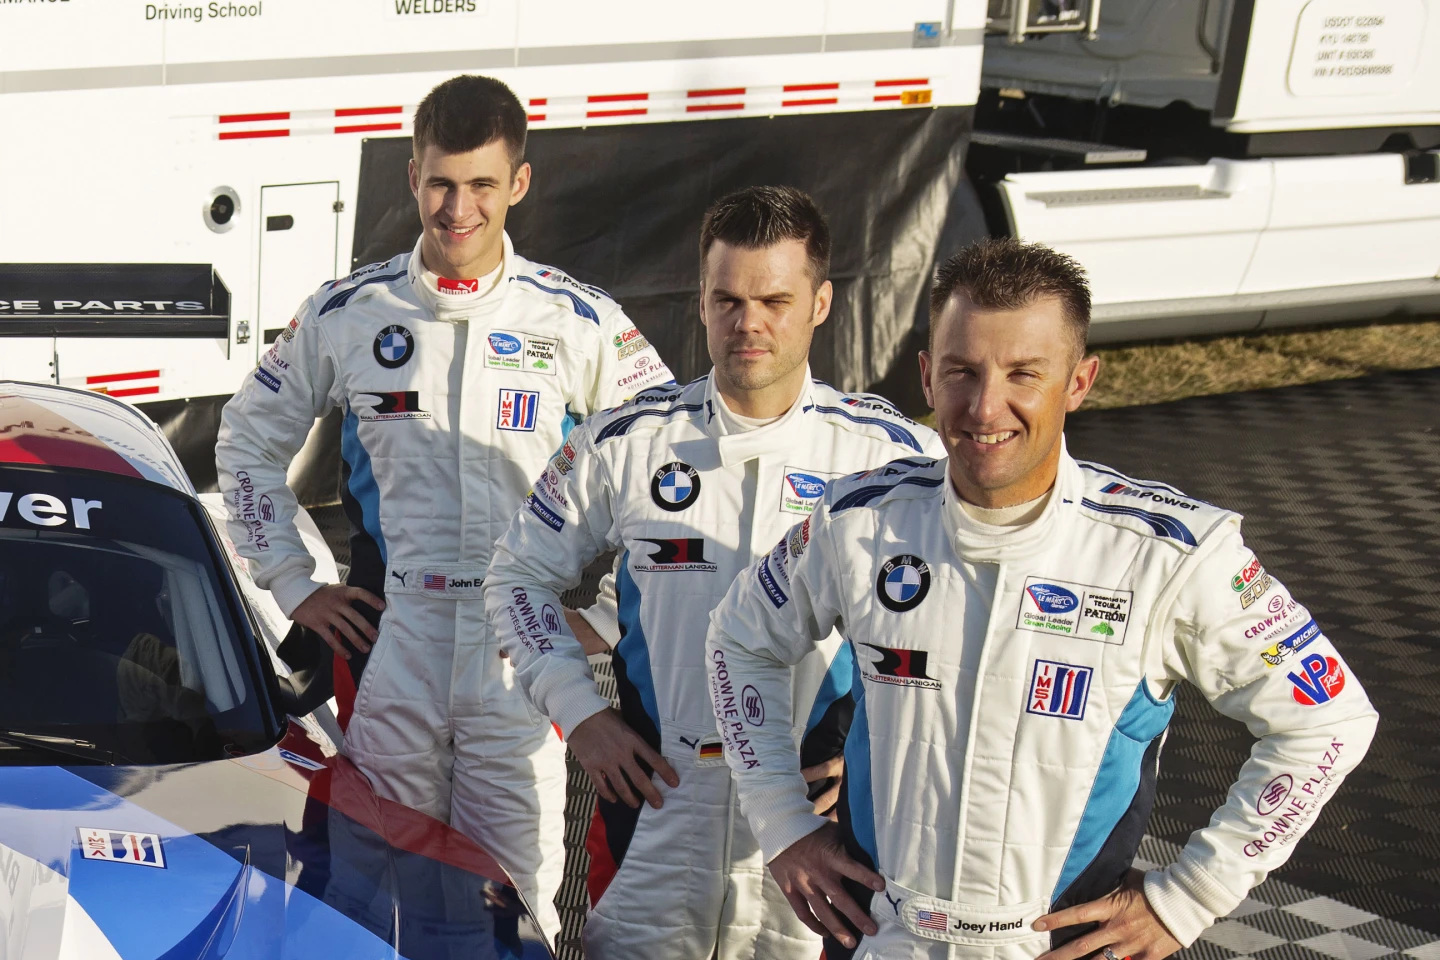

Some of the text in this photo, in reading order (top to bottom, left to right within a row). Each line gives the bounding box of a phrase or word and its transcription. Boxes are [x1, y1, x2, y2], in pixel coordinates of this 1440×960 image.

[145, 2, 262, 22] Driving School
[395, 0, 476, 15] WELDERS
[54, 300, 206, 311] PARTS
[377, 325, 412, 341] BMW
[617, 368, 647, 387] CROWNE
[635, 391, 683, 406] Power
[872, 403, 919, 427] Power
[656, 462, 698, 480] BMW
[1139, 489, 1201, 512] Power
[236, 470, 255, 521] CROWNE
[251, 519, 269, 551] PLAZ
[533, 501, 563, 527] MICHELIN
[884, 555, 929, 574] BMW
[449, 579, 472, 588] John
[1088, 594, 1128, 604] presented by
[1093, 600, 1121, 610] TEQUILA
[1023, 612, 1074, 626] Global Leader
[1084, 607, 1127, 623] PATRÓN
[1244, 609, 1288, 639] CROWNE
[1045, 620, 1072, 634] Racing
[905, 678, 942, 689] LANIGAN
[1286, 652, 1331, 705] VP
[1032, 665, 1052, 712] IMSA
[713, 649, 761, 770] CROWNE PLAZA
[1243, 739, 1344, 858] CROWNE PLAZA
[1279, 816, 1307, 846] HOTELS
[1310, 772, 1337, 809] RESORTS
[953, 918, 1023, 934] Joey Hand
